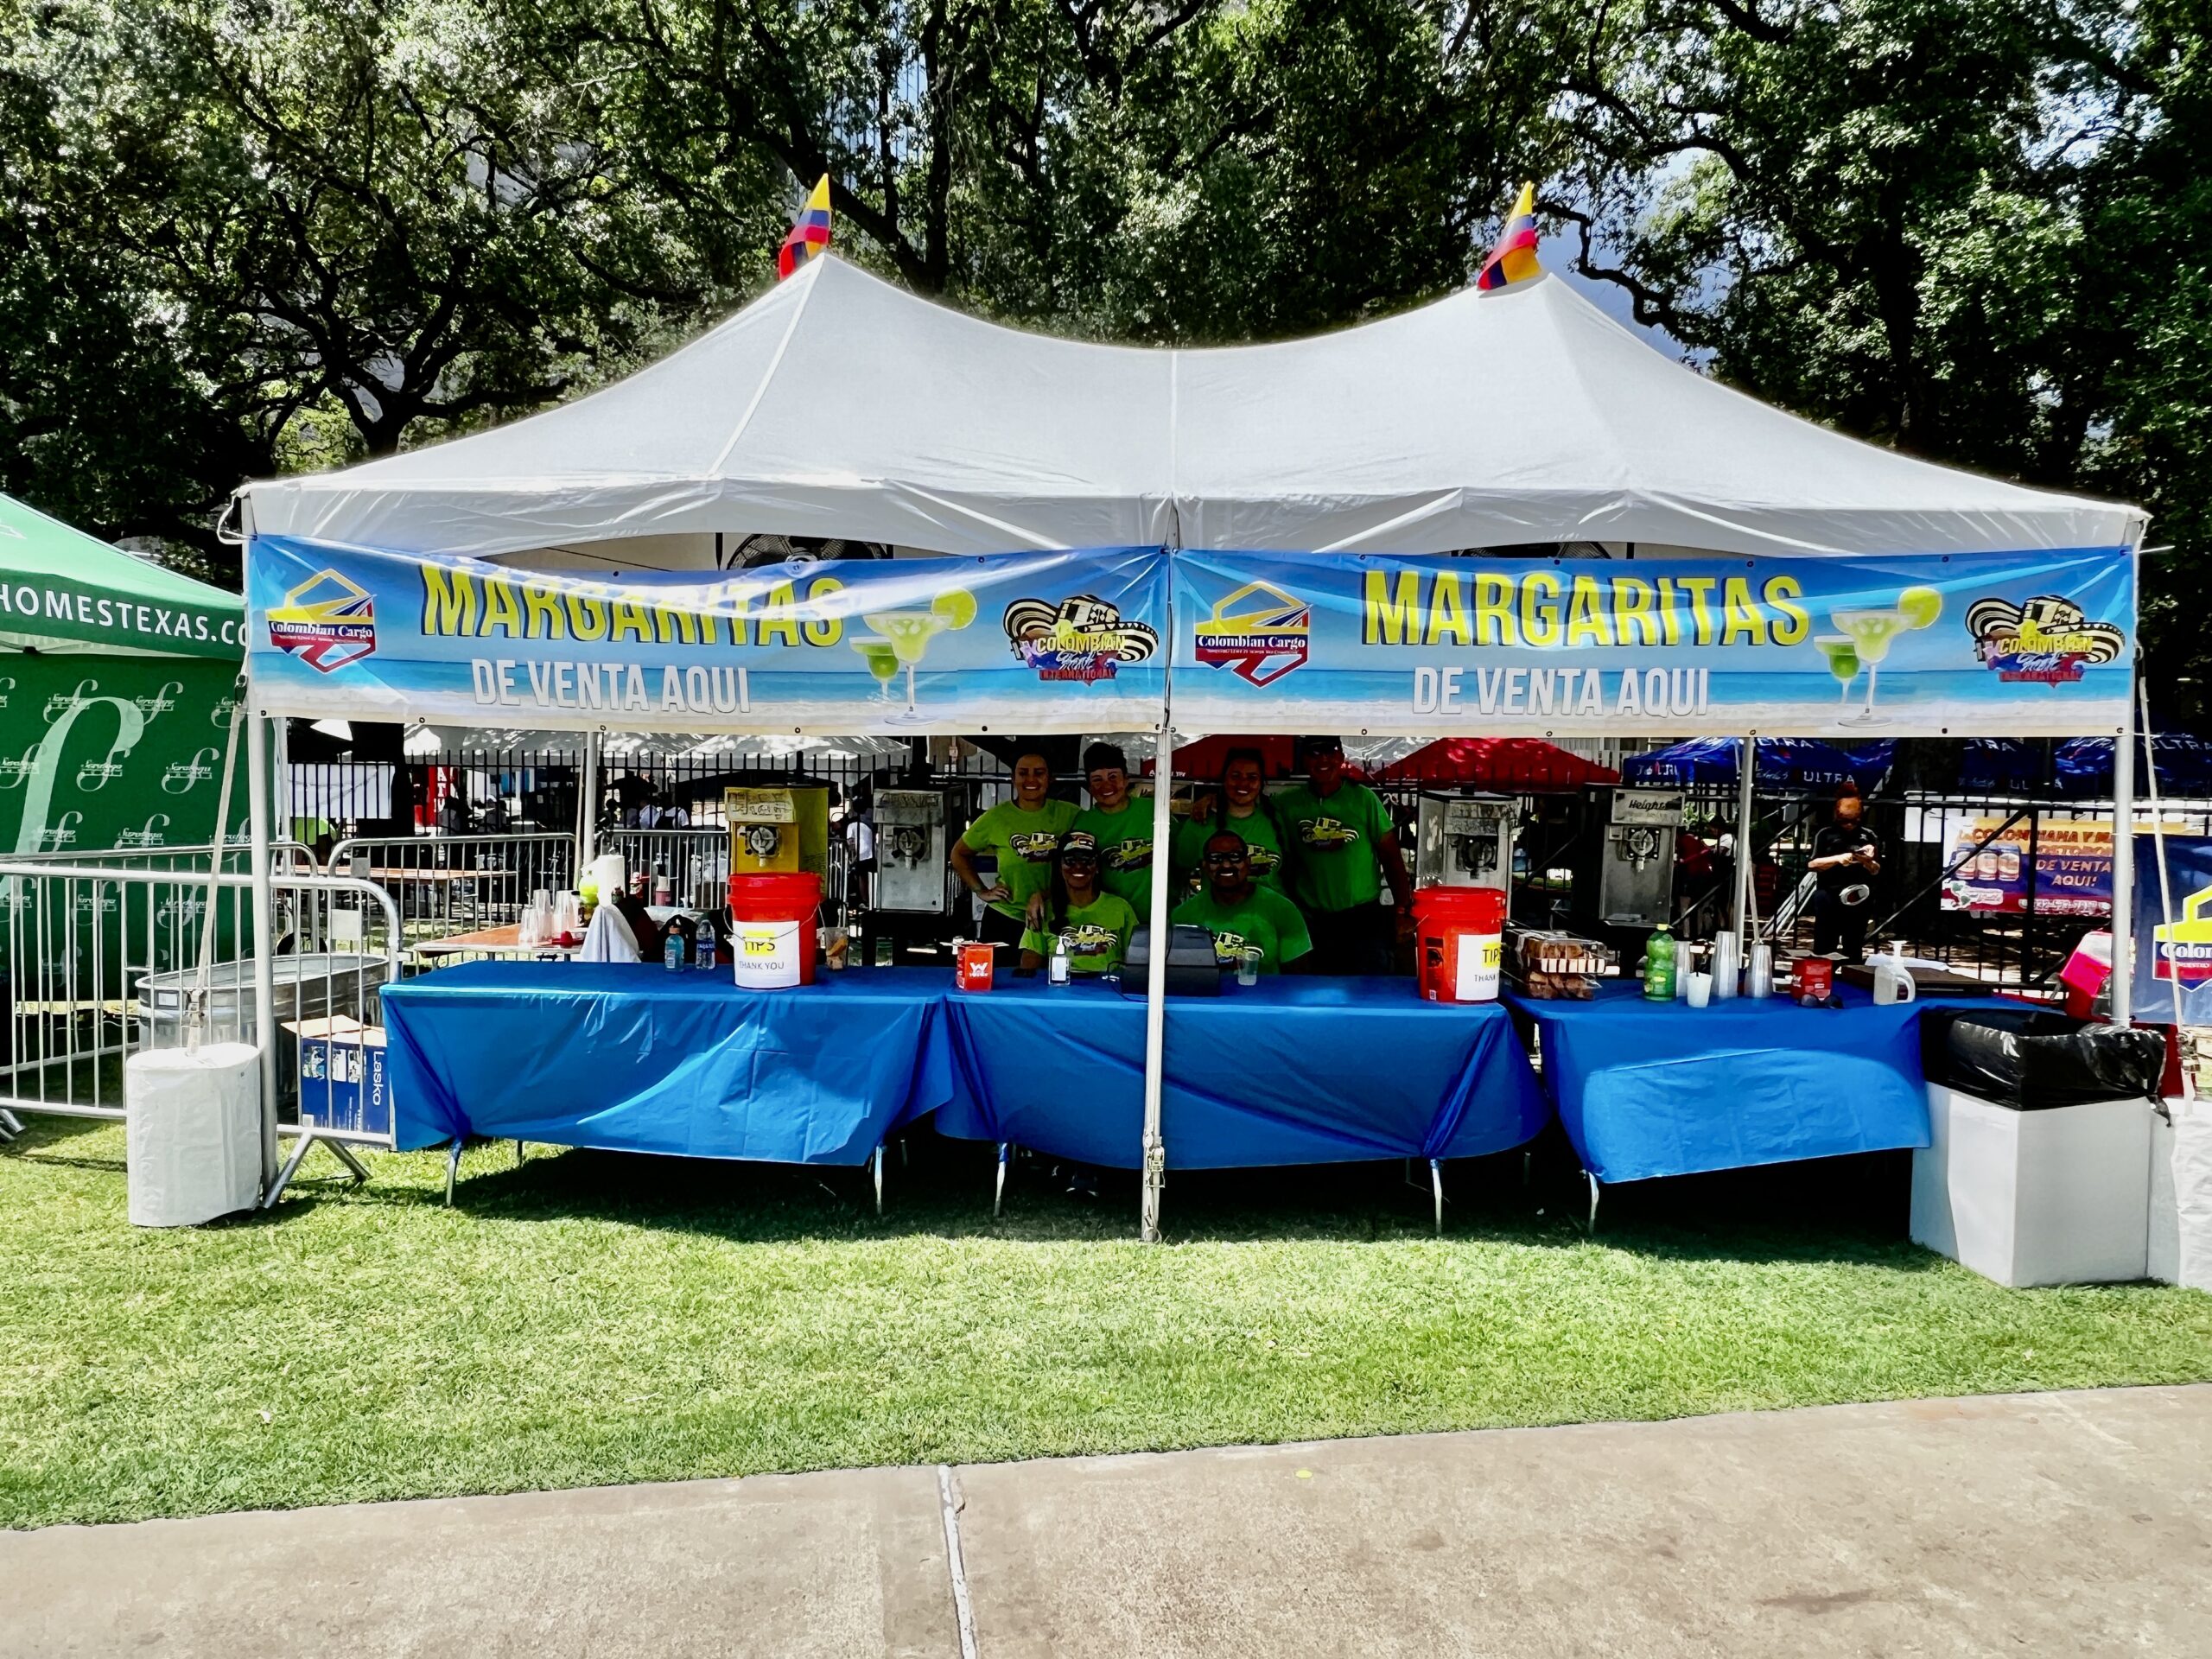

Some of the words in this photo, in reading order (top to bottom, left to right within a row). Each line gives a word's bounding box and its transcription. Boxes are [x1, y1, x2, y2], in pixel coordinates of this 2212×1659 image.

[421, 563, 845, 647] MARGARITAS
[1361, 570, 1810, 650] MARGARITAS
[270, 621, 335, 636] Colombian
[338, 625, 373, 639] Cargo
[1037, 635, 1126, 653] COLOMBIAN
[1198, 635, 1265, 647] Colombian
[1268, 636, 1306, 650] Cargo
[1999, 636, 2094, 654] COLOMBIAN
[472, 658, 516, 706] DE
[528, 661, 650, 711] VENTA
[660, 665, 751, 714] AQUI
[1413, 667, 1463, 715] DE
[1477, 668, 1604, 716] VENTA
[1615, 668, 1708, 718] AQUI
[1803, 771, 1855, 785] ULTRA
[2061, 861, 2111, 872] VENTA
[765, 961, 785, 969] YOU
[372, 1051, 385, 1106] Lasko
